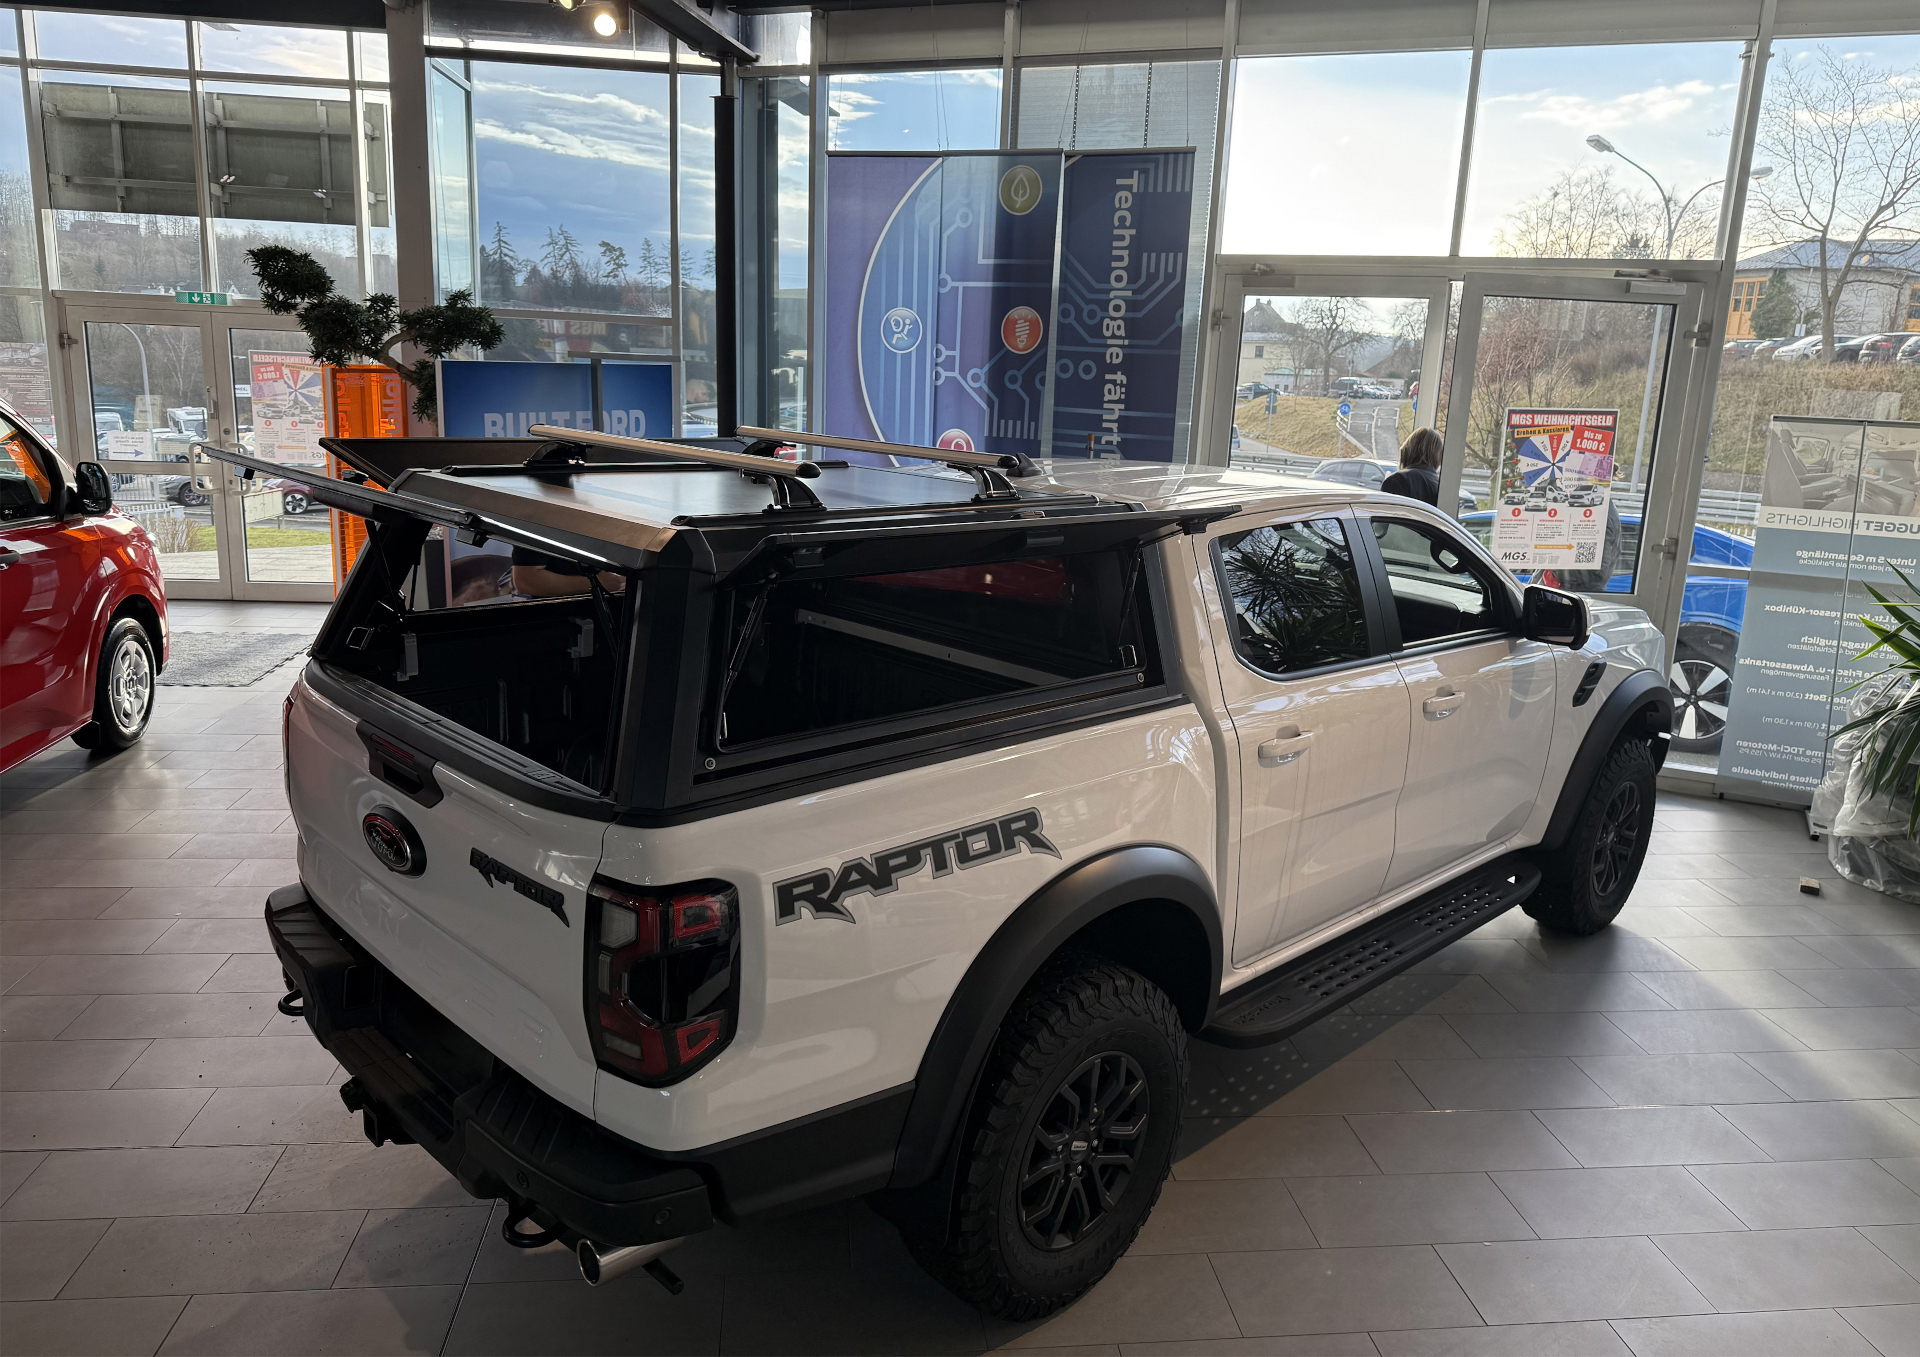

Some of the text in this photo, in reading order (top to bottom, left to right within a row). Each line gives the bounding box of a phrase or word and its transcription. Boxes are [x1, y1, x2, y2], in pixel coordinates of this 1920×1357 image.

[1103, 170, 1139, 365] Technologie
[1100, 371, 1128, 446] fährt
[1511, 415, 1613, 426] MGS WEIHNACHTSGELD
[1576, 439, 1606, 451] 1.000 €
[1584, 431, 1594, 439] Bis
[1501, 551, 1527, 561] MGS
[469, 847, 570, 928] RAPTOR
[772, 806, 1062, 926] RAPTOR
